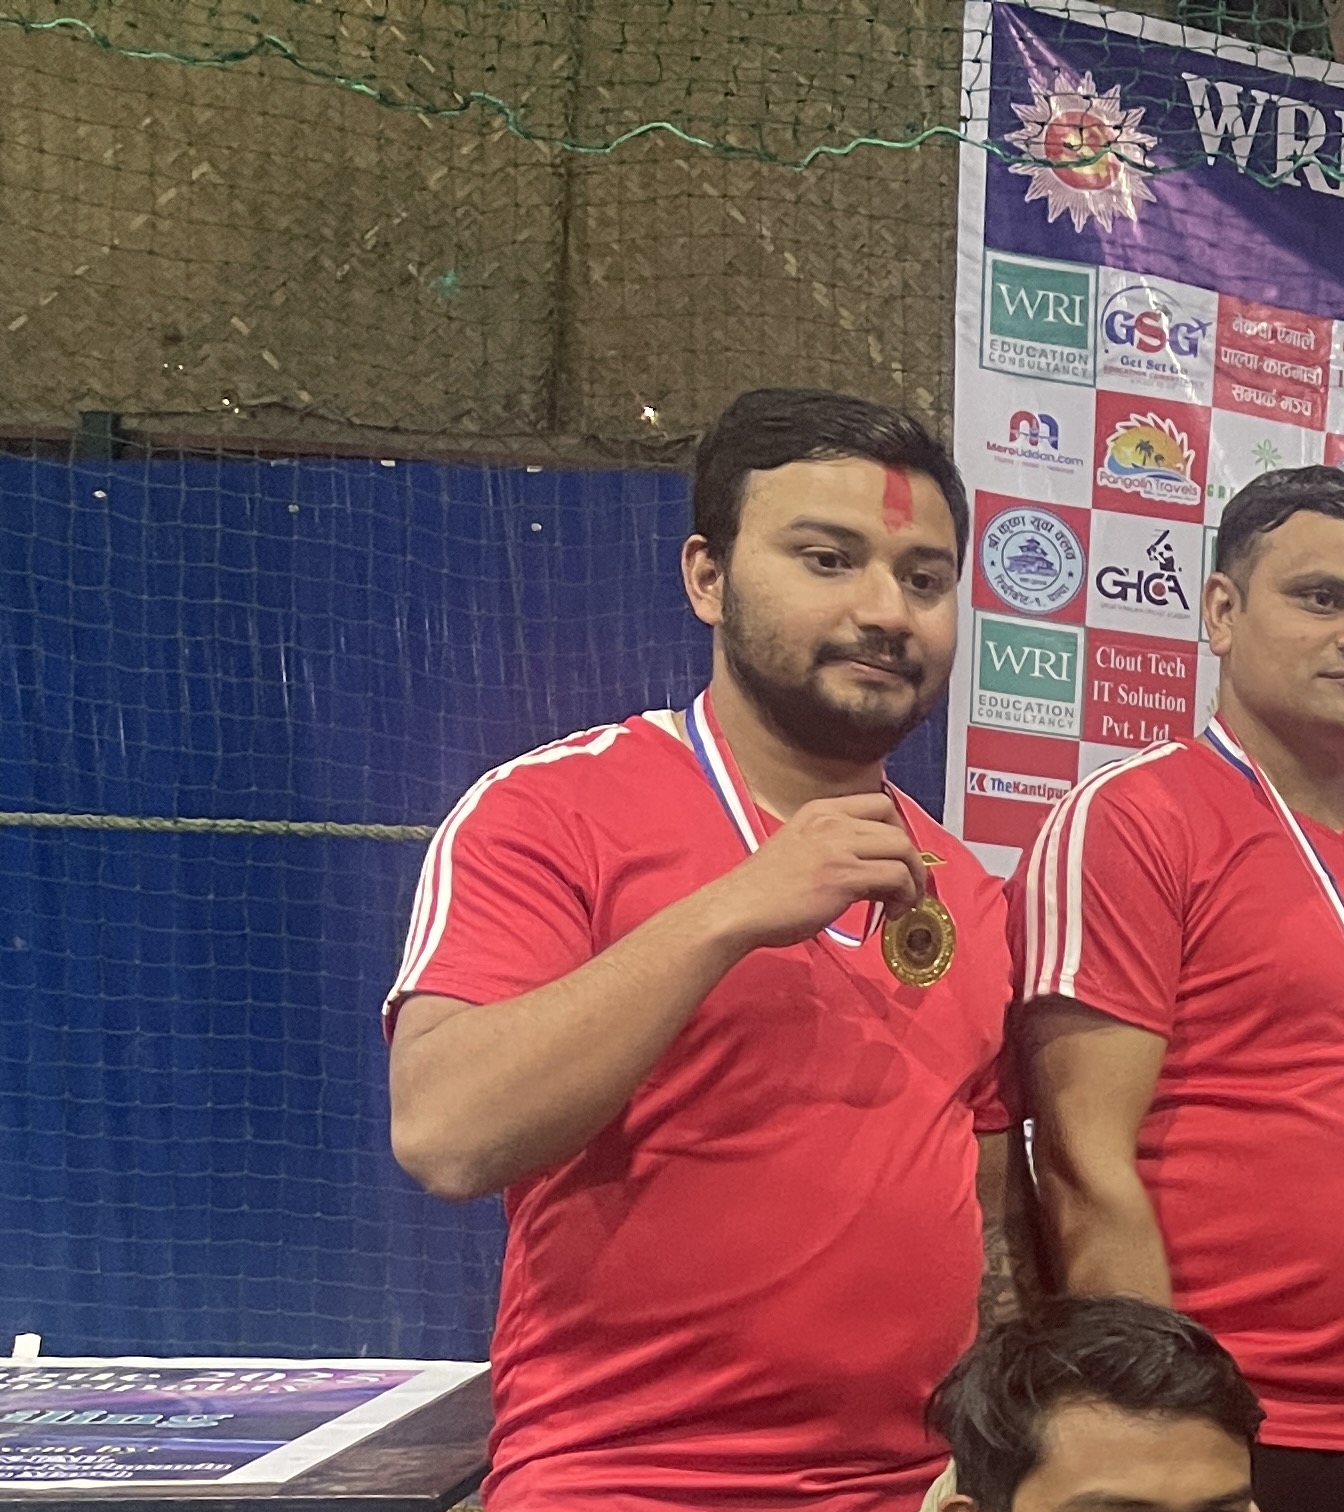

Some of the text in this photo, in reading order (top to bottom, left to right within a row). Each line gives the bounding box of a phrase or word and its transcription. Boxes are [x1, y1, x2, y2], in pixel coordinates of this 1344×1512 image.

[996, 283, 1086, 327] WRI
[1105, 310, 1203, 359] GSG
[988, 353, 1088, 378] CONSULTANCY
[989, 338, 1090, 366] EDUCATION
[1100, 471, 1153, 493] Pangolin
[1155, 476, 1198, 497] Travels
[1096, 565, 1190, 611] GHCA
[985, 640, 1073, 682] WRI
[1095, 646, 1186, 679] Clout Tech
[978, 694, 1075, 719] EDUCATION
[1092, 680, 1187, 713] IT Solution
[977, 706, 1074, 729] CONSULTANCY
[1101, 715, 1134, 740] Pvt.
[990, 776, 1071, 801] TheKantipur
